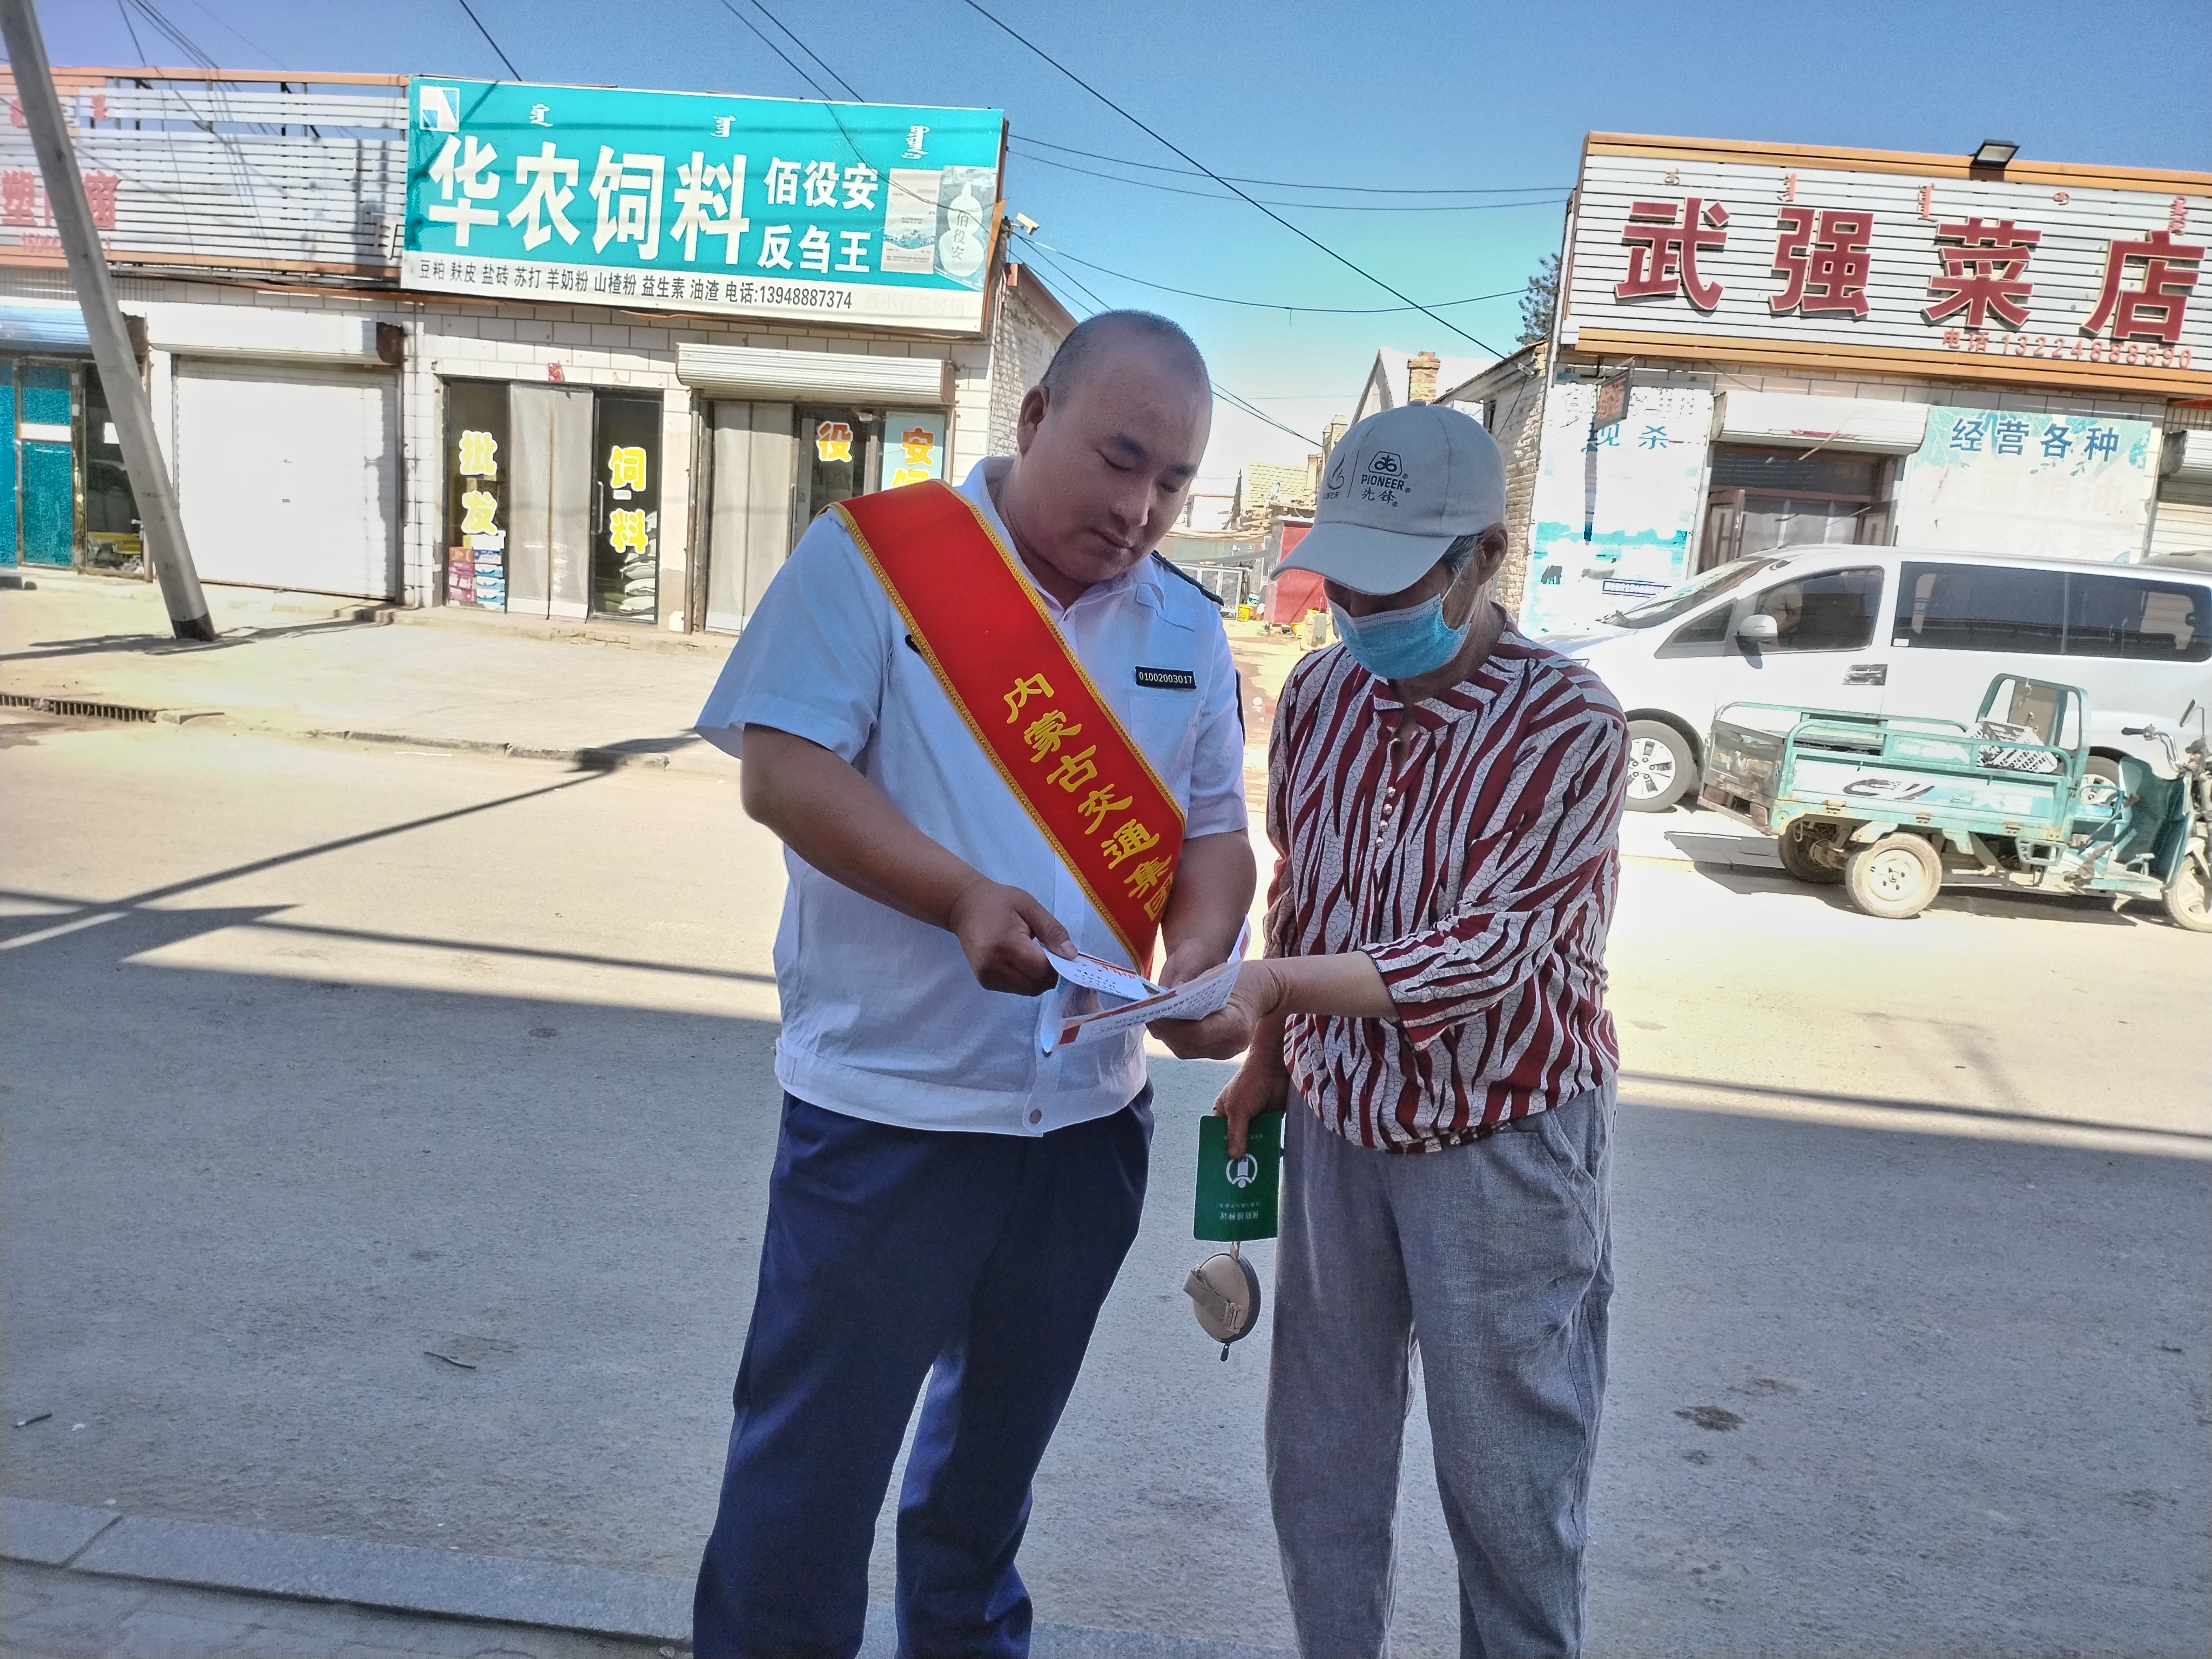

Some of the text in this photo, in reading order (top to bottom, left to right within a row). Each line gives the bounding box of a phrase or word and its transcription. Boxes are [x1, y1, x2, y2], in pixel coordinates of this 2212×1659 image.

[429, 134, 750, 265] 华农饲料
[764, 157, 879, 211] 佰役安
[757, 224, 872, 274] 反刍王
[1615, 198, 2206, 342] 武强菜店
[419, 259, 853, 309] 豆粕 麸皮 盐砖 苏打 羊奶粉 山楂粉 益生素 油渣 电话:13948887374
[1942, 328, 2193, 369] 电话 13224888590
[1950, 417, 2120, 463] 经营各种
[458, 429, 498, 536] 批发
[608, 444, 650, 555] 饲料
[1360, 474, 1405, 491] PIONEER
[1361, 487, 1396, 504] 先锋
[1139, 671, 1192, 684] 01002003017
[1002, 672, 1174, 921] 内蒙古交通集团
[1218, 1210, 1260, 1222] 预防接种证
